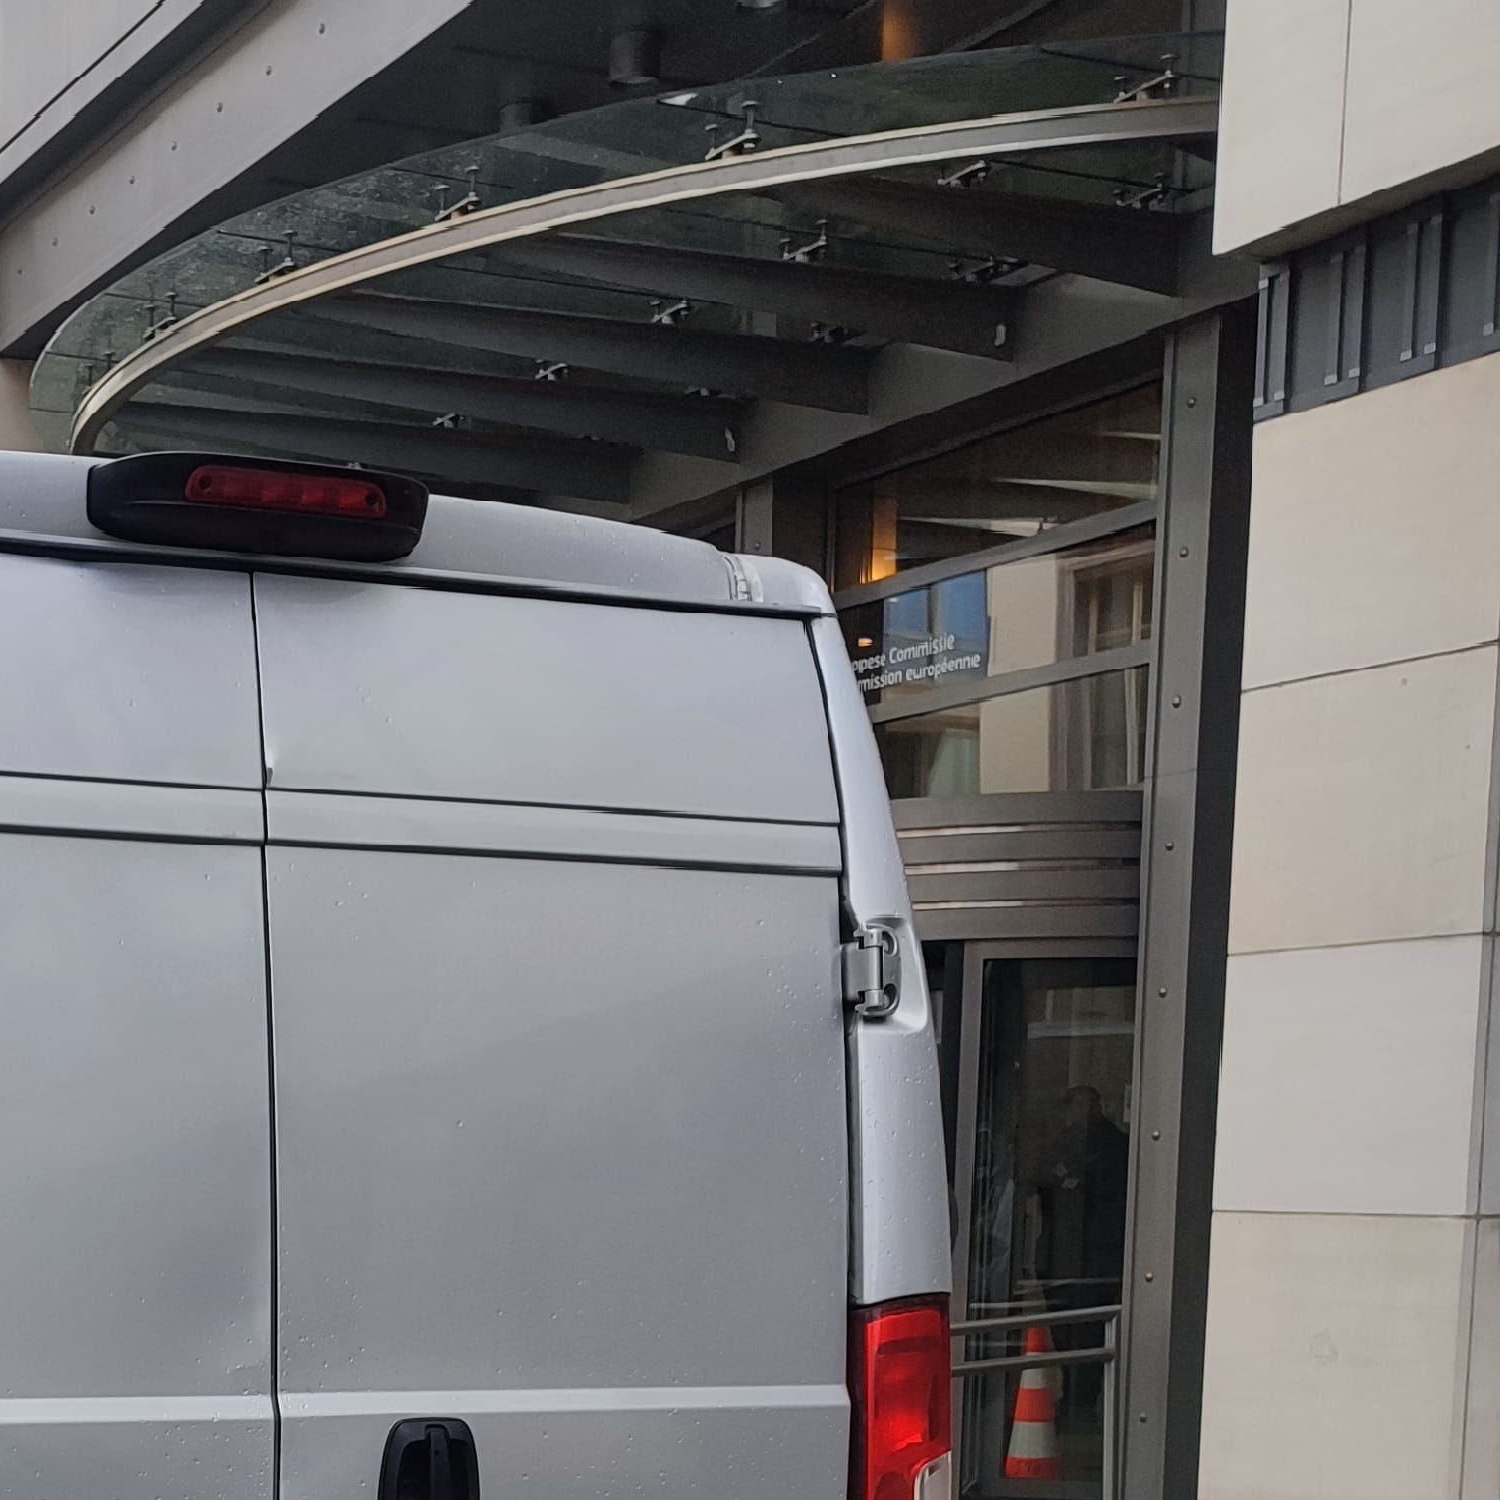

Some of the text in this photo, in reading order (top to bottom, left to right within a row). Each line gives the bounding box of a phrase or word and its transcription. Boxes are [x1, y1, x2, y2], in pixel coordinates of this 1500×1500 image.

[851, 632, 956, 673] opese Commissie
[858, 653, 981, 692] mission européenne
